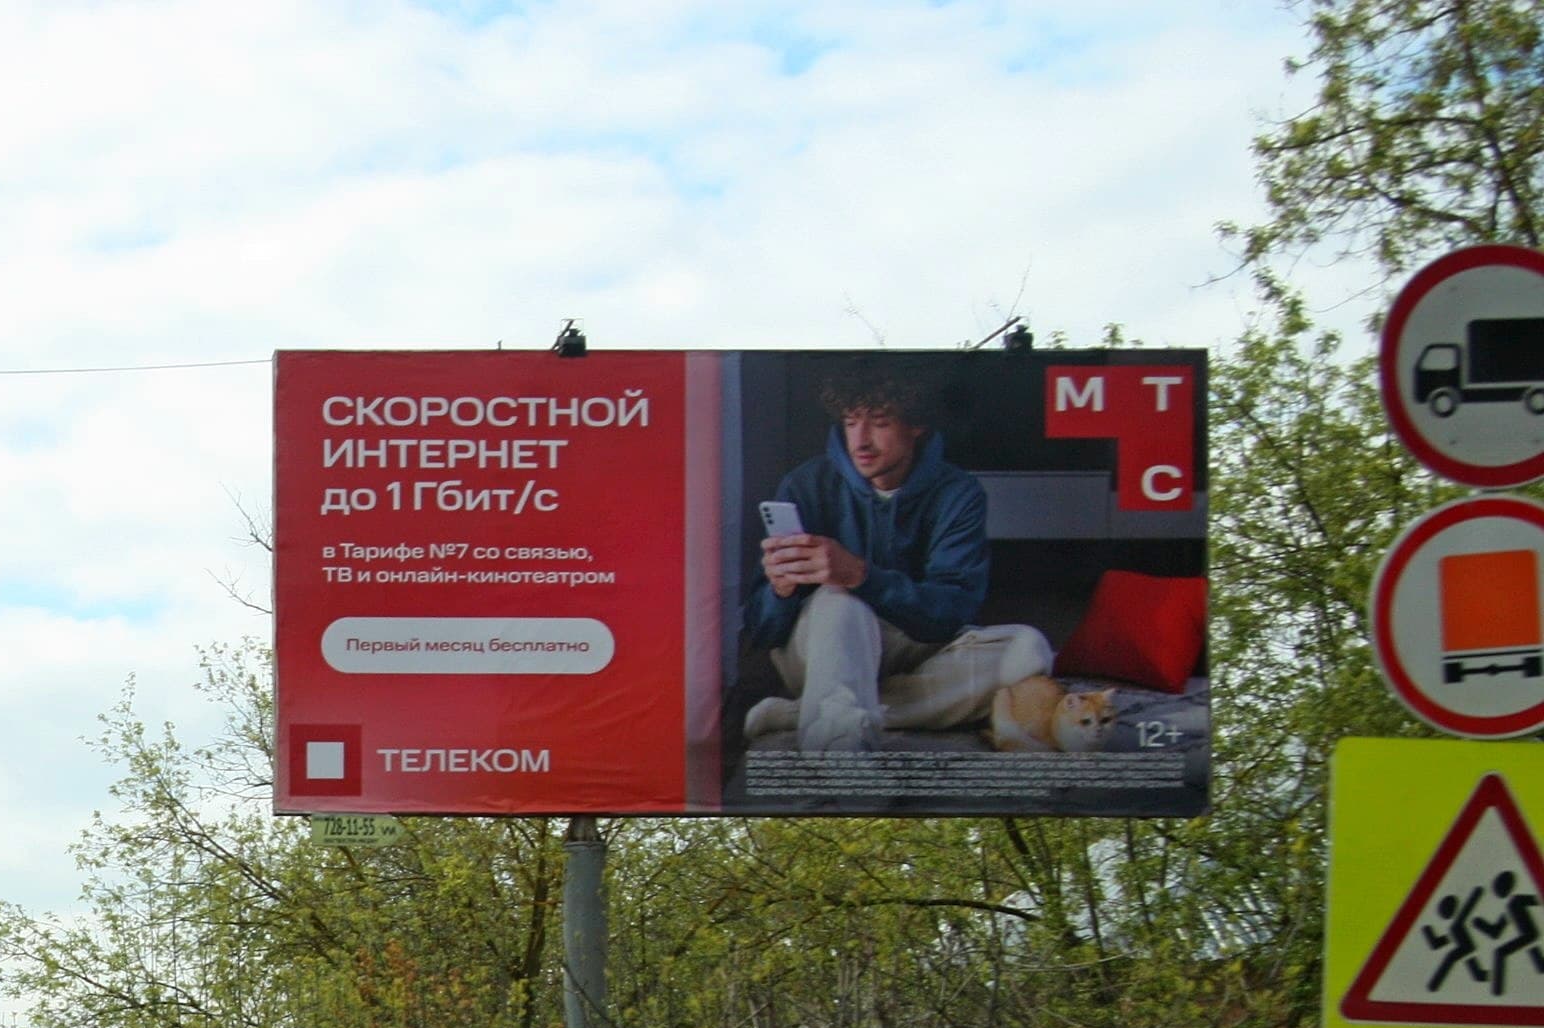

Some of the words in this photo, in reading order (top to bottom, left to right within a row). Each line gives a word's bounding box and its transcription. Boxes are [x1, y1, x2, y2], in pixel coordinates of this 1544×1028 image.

[322, 390, 649, 427] СКОРОСТНОЙ
[323, 439, 568, 469] ИНТЕРНЕТ
[320, 488, 377, 515] до
[386, 481, 401, 510] 1
[413, 480, 559, 515] Гбит/с
[322, 546, 336, 559] в
[339, 542, 425, 562] Тарифе
[473, 547, 500, 560] со
[504, 547, 593, 562] связью,
[322, 567, 353, 583] ТВ
[357, 570, 371, 583] и
[376, 566, 615, 587] онлайн-кинотеатром
[346, 638, 420, 654] Первый
[425, 640, 485, 653] месяц
[489, 638, 590, 652] бесплатно
[1136, 721, 1184, 747] 12+
[377, 748, 550, 773] ТЕЛЕКОМ
